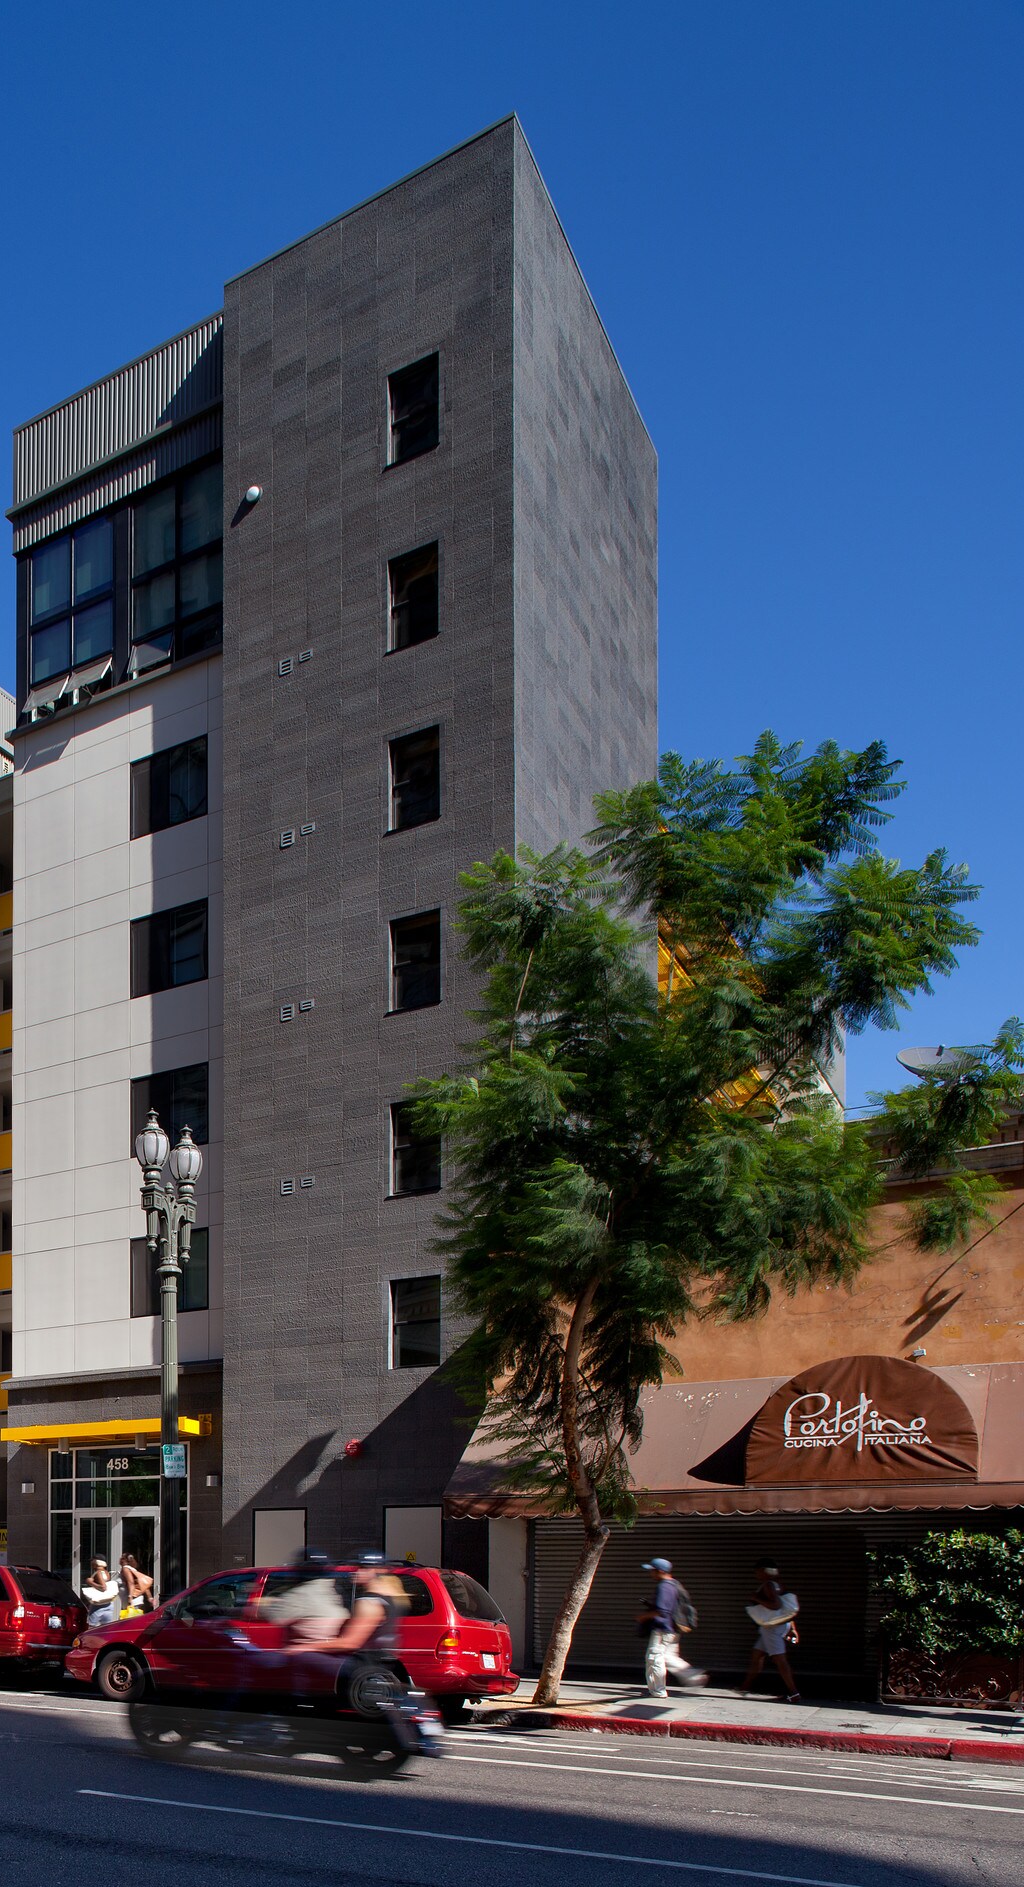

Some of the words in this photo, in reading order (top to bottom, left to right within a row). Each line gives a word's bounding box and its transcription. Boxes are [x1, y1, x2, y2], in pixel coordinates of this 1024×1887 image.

[784, 1392, 926, 1451] Portofino
[784, 1438, 838, 1448] CUCINA
[864, 1435, 933, 1446] ITALIANA
[165, 1446, 171, 1454] 2
[106, 1457, 129, 1471] 458
